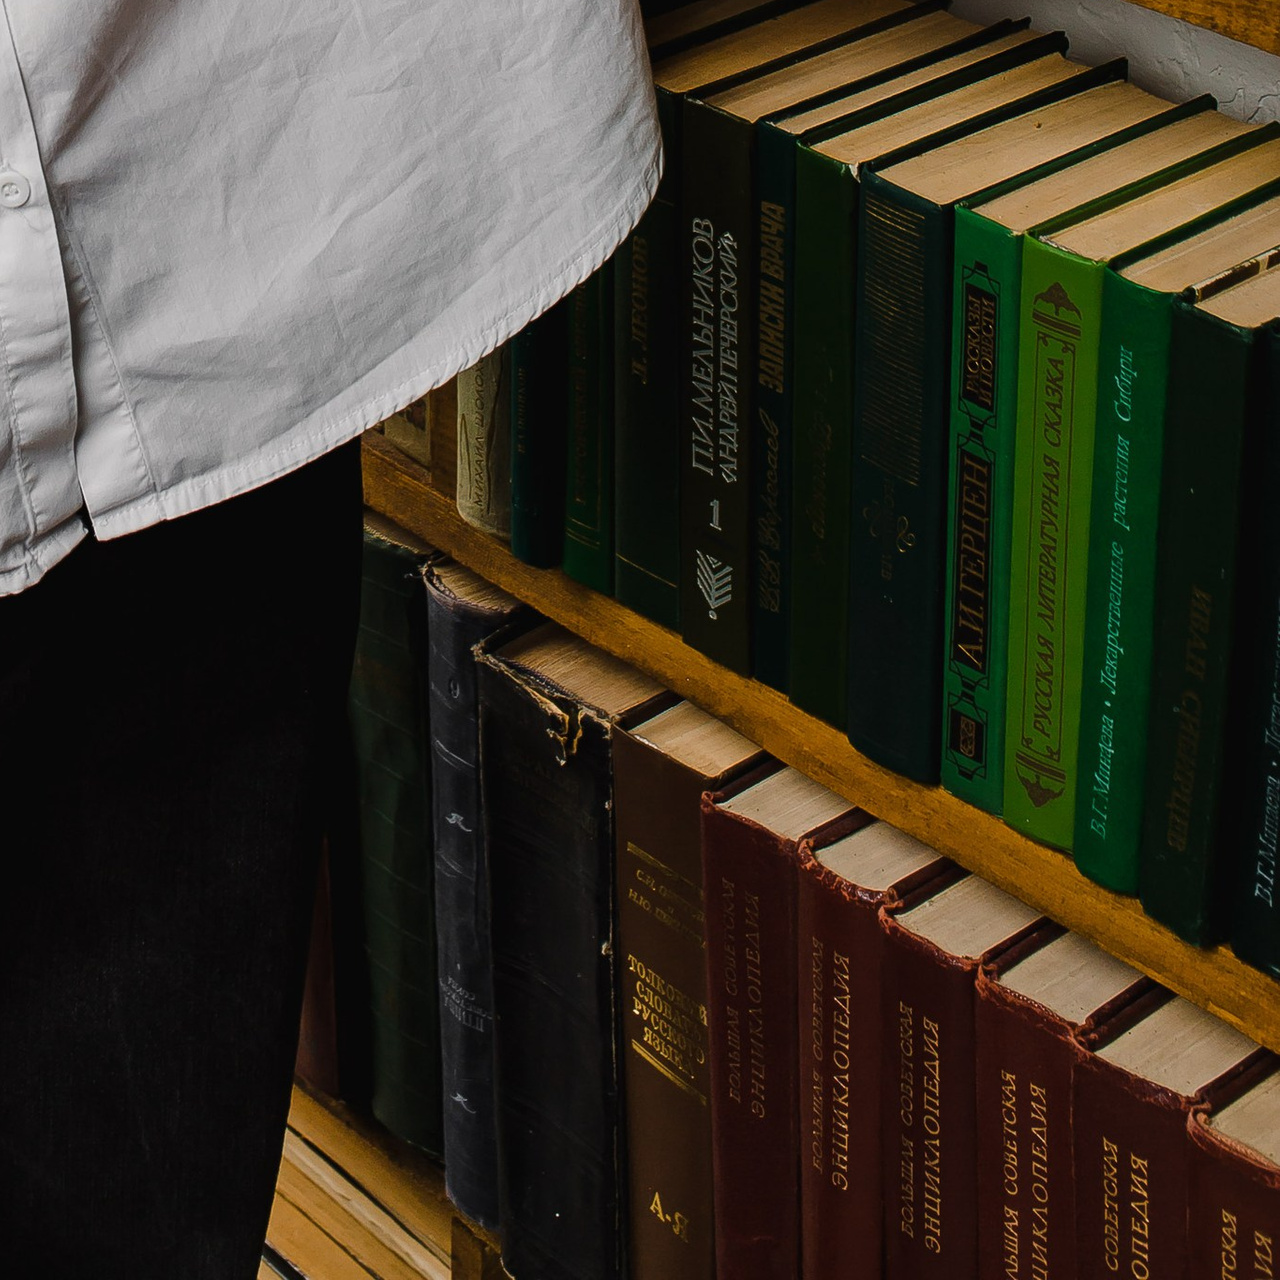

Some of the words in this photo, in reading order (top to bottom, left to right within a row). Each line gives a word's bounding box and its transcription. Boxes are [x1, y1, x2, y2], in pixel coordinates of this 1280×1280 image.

[760, 201, 786, 282] ВРАЧА
[759, 282, 786, 394] ЗАПИСКИ
[965, 293, 981, 396] РАССКАЗЫ
[1112, 345, 1136, 422] Сибири
[473, 358, 487, 428] ШОЛОХ
[1042, 357, 1065, 447] СКАЗКА
[473, 435, 486, 508] МИХАИЛ
[1109, 435, 1132, 529] растения
[1035, 454, 1061, 630] ЛИТЕРАТУРНАЯ
[1097, 541, 1124, 696] Лекарственные
[1031, 635, 1054, 739] РУССКАЯ
[722, 877, 738, 997] СОВЕТСКАЯ
[727, 1006, 742, 1104] БОЛЬШАЯ
[746, 890, 766, 1119] ЭНЦИКЛОПЕДИЯ
[832, 950, 851, 1191] ЭНЦИКЛОПЕДИЯ
[899, 1001, 914, 1127] СОВЕТСКАЯ
[923, 1015, 942, 1254] ЭНЦИКЛОПЕДИЯ
[1001, 1069, 1019, 1195] СОВЕТСКАЯ
[900, 1135, 915, 1239] БОЛЬШАЯ
[1103, 1137, 1119, 1271] СОВЕТСКАЯ
